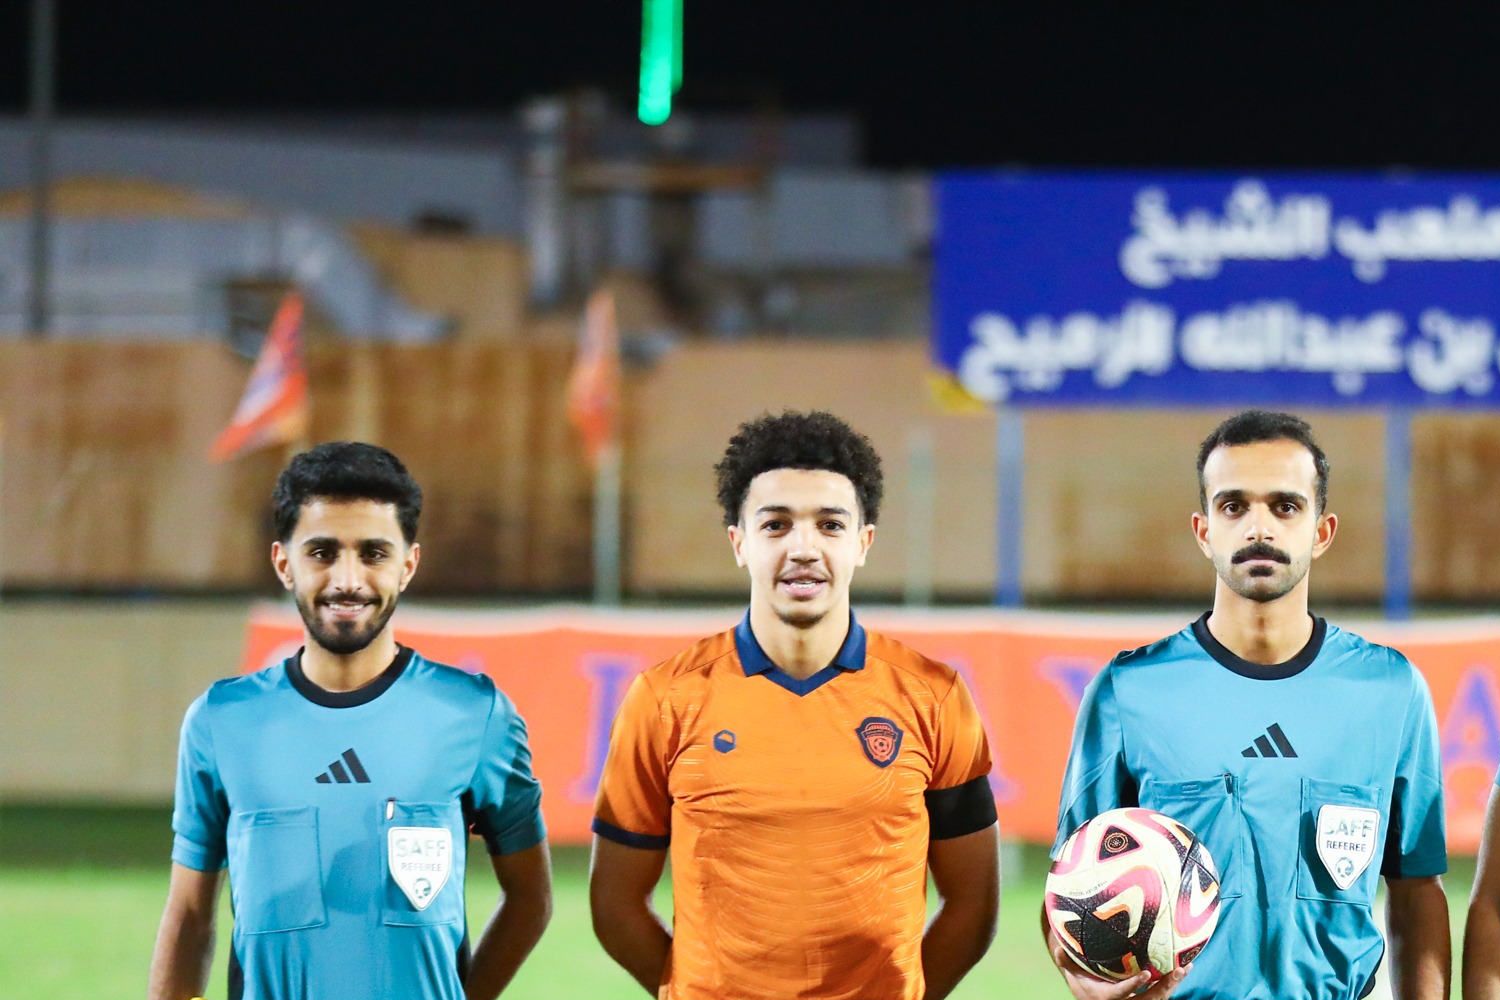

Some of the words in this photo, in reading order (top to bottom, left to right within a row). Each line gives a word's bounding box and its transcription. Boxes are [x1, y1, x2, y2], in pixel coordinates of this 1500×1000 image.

[1119, 179, 1331, 289] الشيخ
[1406, 307, 1494, 396] بن
[395, 838, 446, 857] SAFF
[1326, 840, 1367, 852] REFEREE
[401, 862, 442, 872] REFEREE
